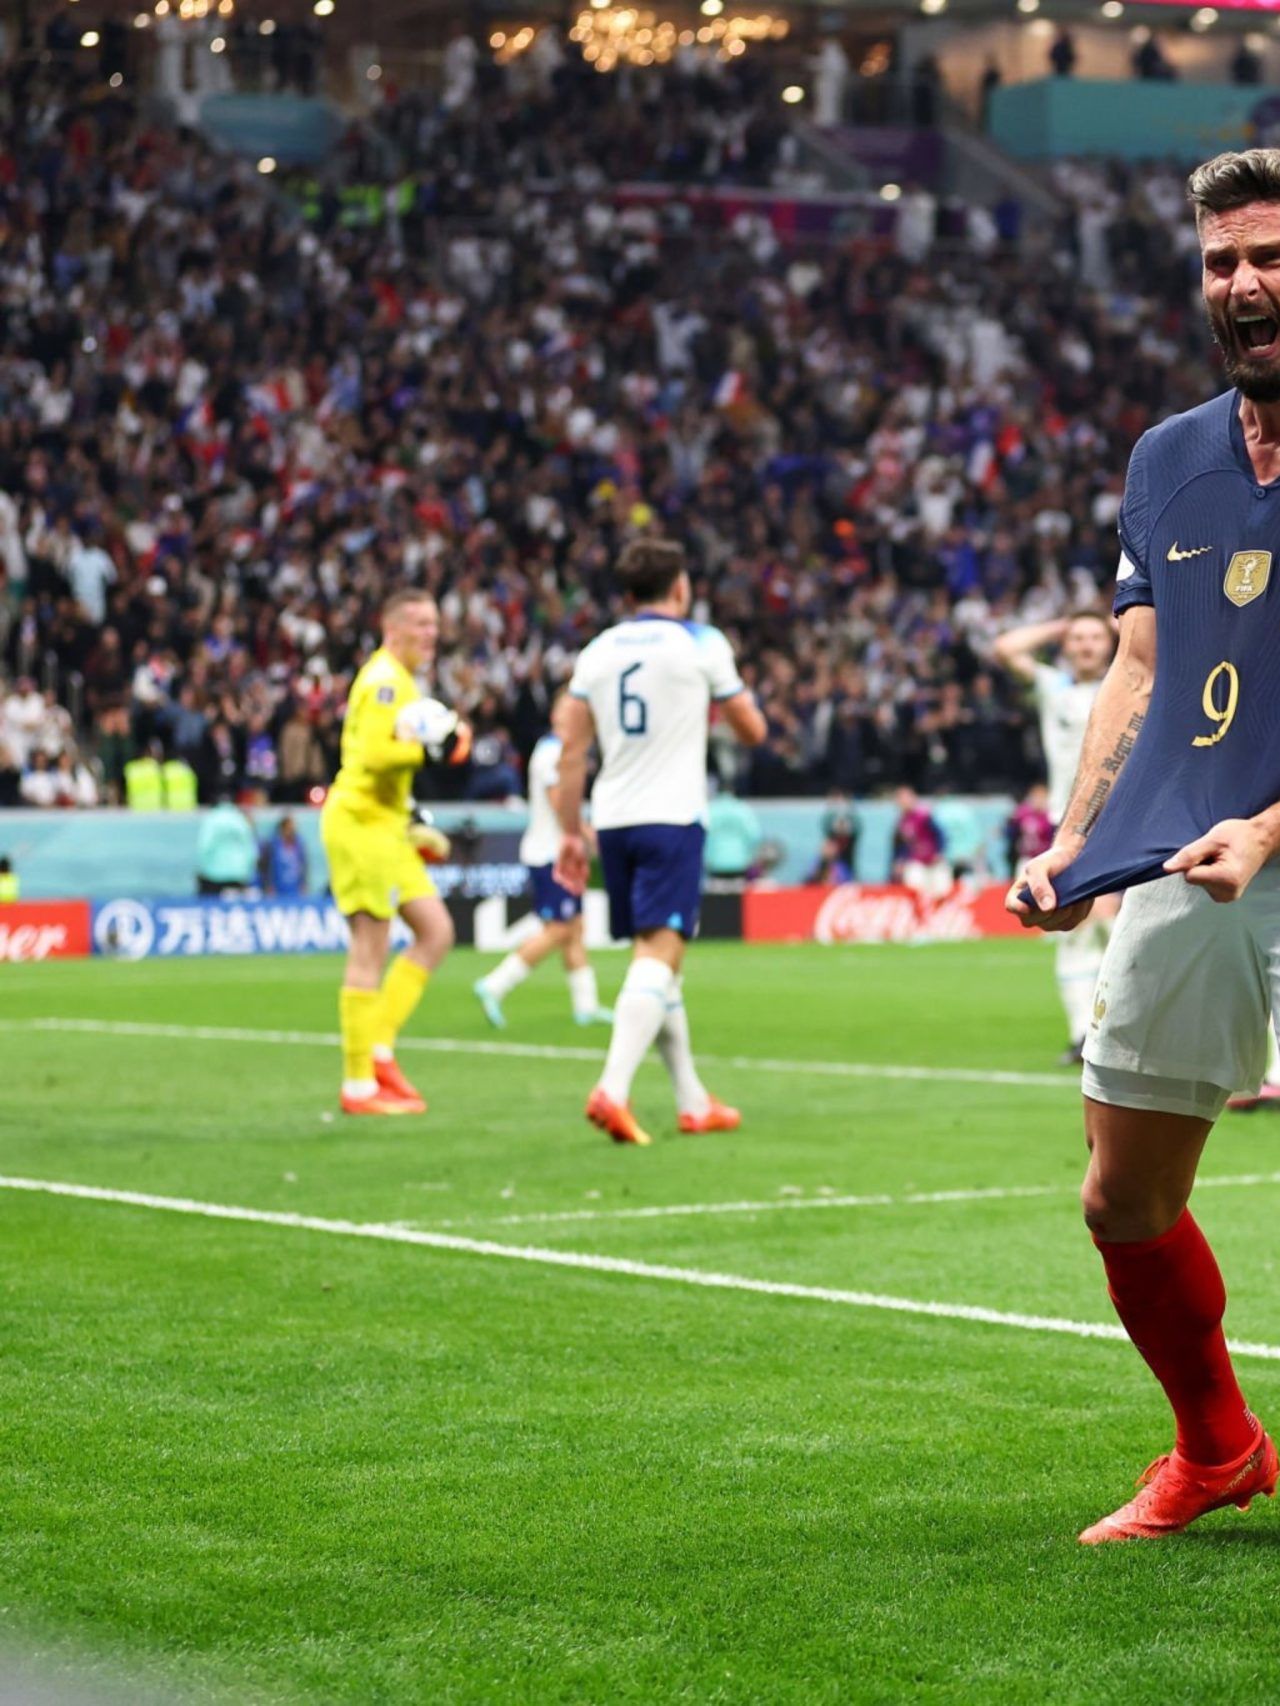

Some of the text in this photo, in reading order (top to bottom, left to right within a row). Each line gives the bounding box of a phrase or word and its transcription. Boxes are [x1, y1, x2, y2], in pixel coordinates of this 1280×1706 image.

[617, 661, 648, 736] 6
[1191, 661, 1240, 748] 9
[158, 906, 256, 954] 万达
